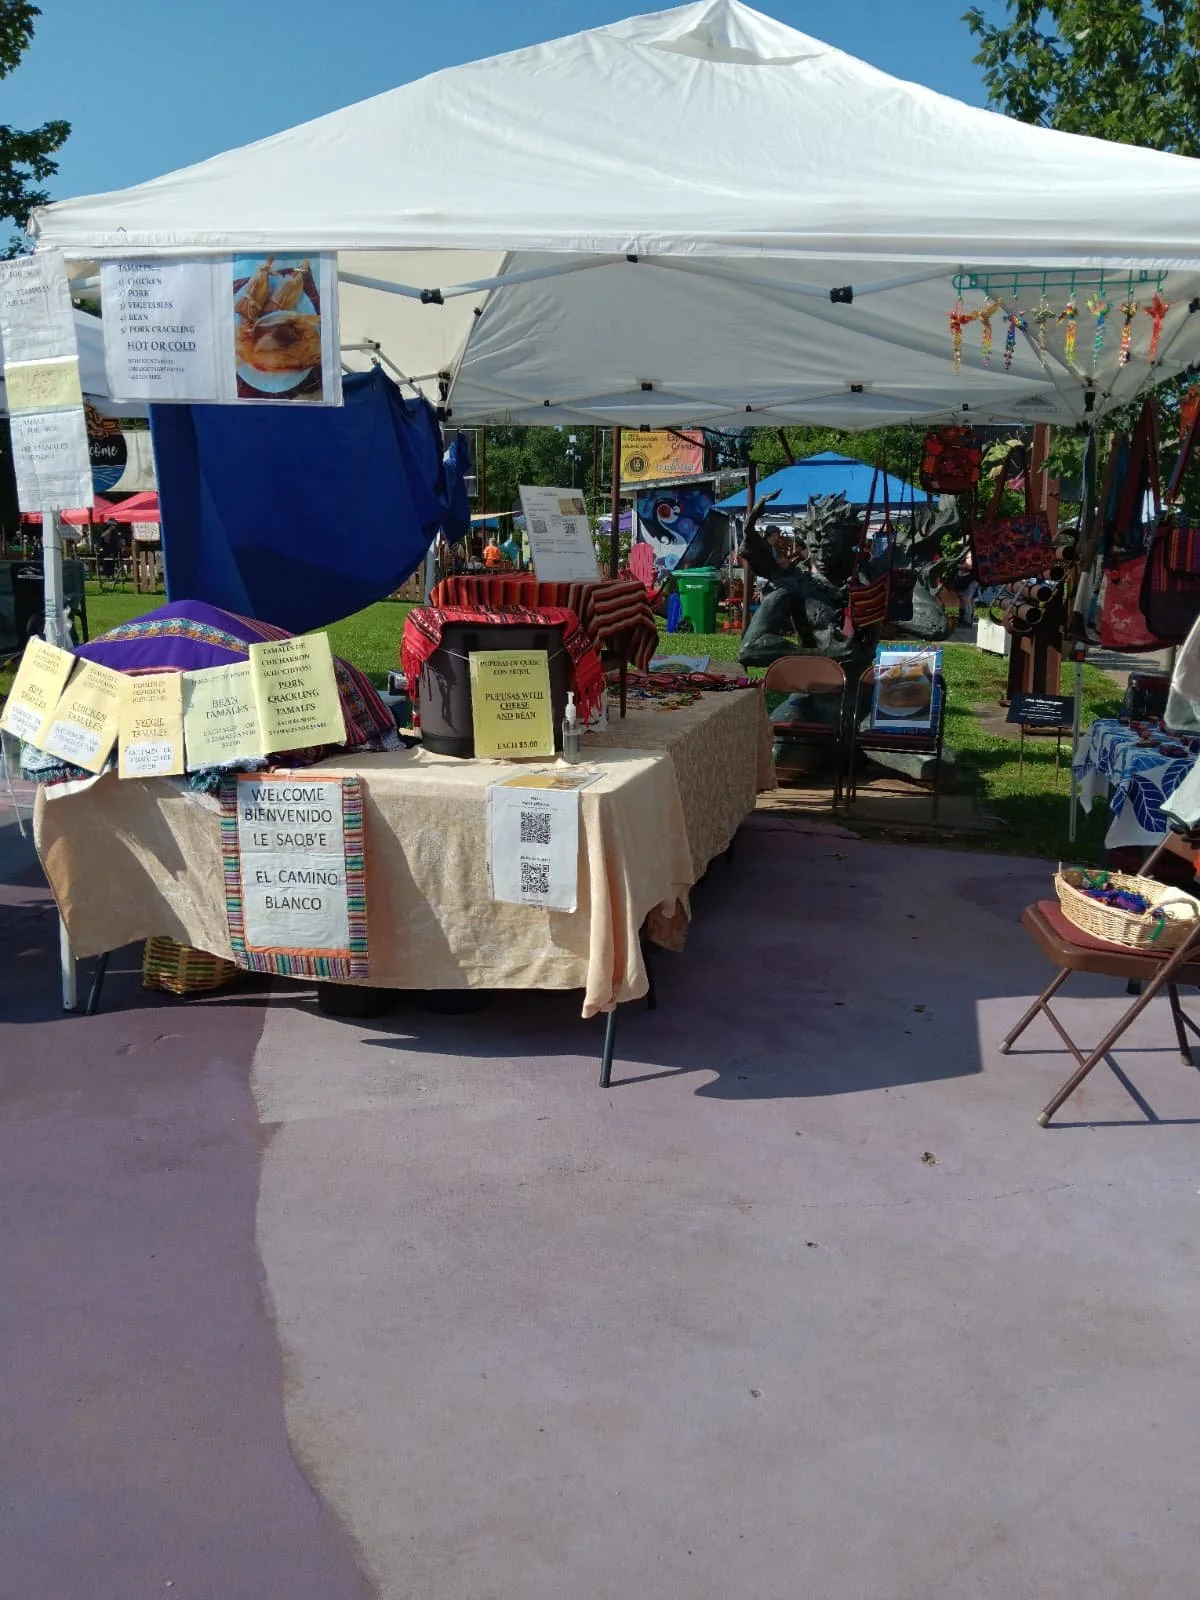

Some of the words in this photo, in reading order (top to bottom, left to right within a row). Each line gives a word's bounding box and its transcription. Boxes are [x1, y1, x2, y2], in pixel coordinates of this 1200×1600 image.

[128, 289, 149, 297] PORK
[128, 301, 174, 309] VEGETABLES
[130, 325, 150, 333] PORK
[152, 325, 195, 333] CRACKLING
[127, 341, 149, 351] HOT
[151, 340, 166, 350] OR
[168, 341, 196, 351] COLD
[263, 644, 295, 655] TAMALES
[278, 680, 304, 689] PORK
[212, 695, 238, 709] BEAN
[267, 688, 320, 704] CRACKLING
[485, 692, 521, 701] PUPUSAS
[522, 691, 544, 700] WITH
[71, 702, 107, 722] CHICKEN
[206, 704, 249, 719] TAMALES
[275, 703, 316, 716] TAMALES
[500, 702, 530, 710] CHEESE
[67, 711, 103, 731] TAMALES
[496, 712, 514, 720] AND
[515, 711, 536, 720] BEAN
[132, 728, 168, 738] TAMALES
[251, 788, 325, 801] WELCOME
[244, 808, 333, 823] BIENVENIDO
[253, 833, 269, 846] LE
[255, 871, 272, 883] EL
[278, 870, 338, 886] CAMINO
[265, 896, 322, 911] BLANCO
